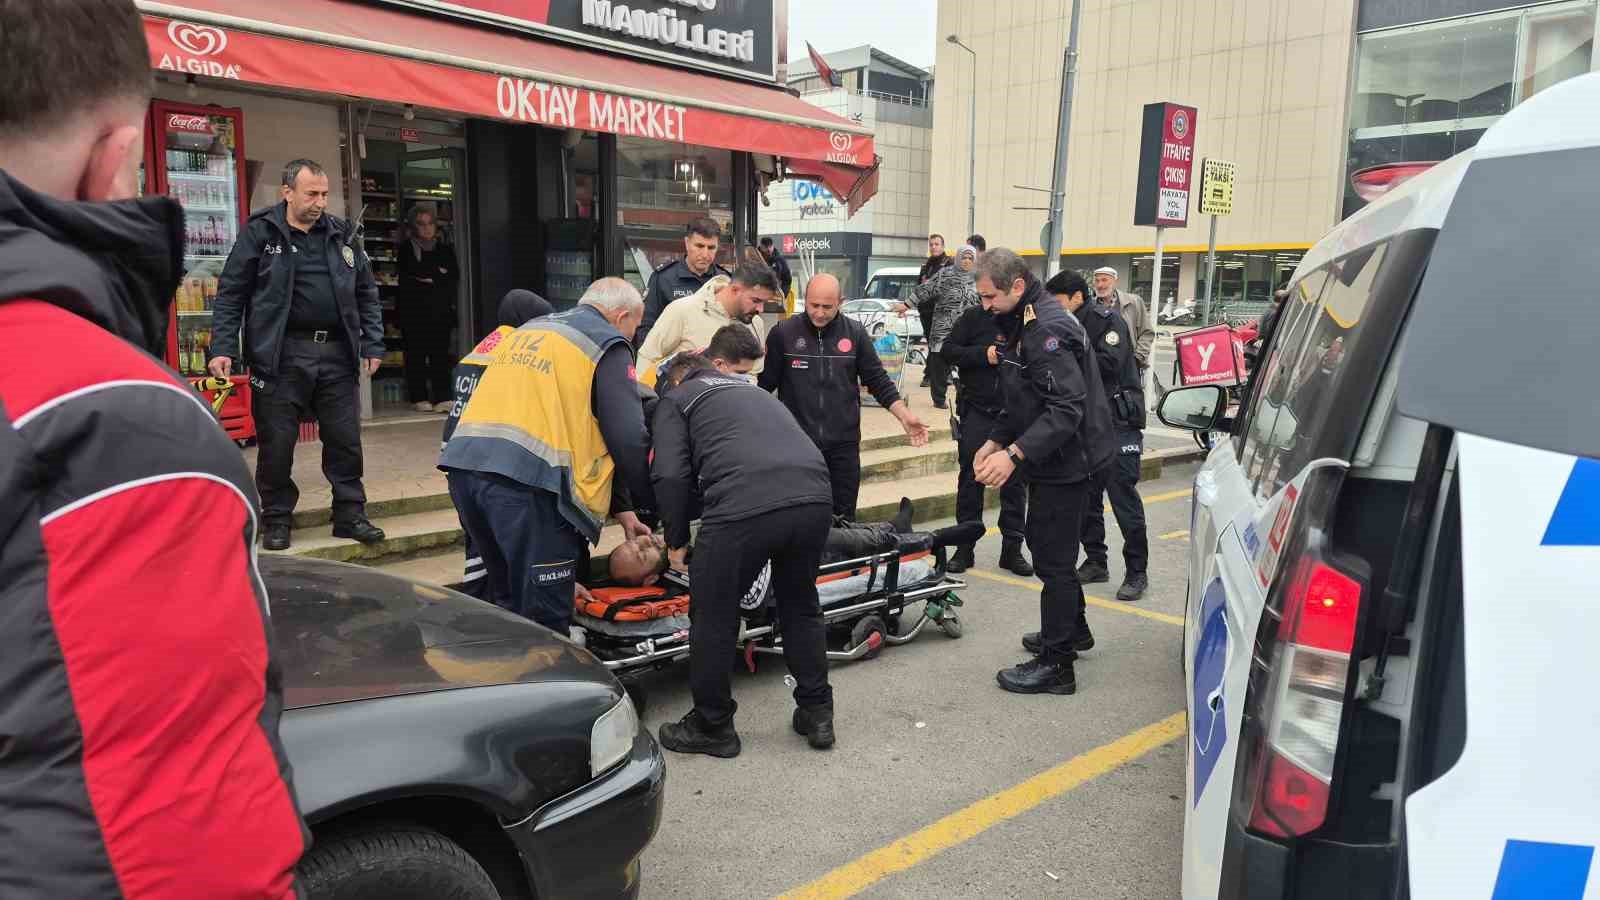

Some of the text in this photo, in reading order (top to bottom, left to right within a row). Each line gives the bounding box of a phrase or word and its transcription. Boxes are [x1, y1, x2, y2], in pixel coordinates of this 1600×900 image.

[496, 77, 687, 141] OKTAY MARKET
[1163, 139, 1191, 161] İTFAİYE
[1161, 189, 1187, 199] HAYATA
[800, 201, 834, 219] yatak
[1166, 201, 1181, 209] YOL
[1165, 210, 1180, 218] VER
[794, 235, 831, 250] Kelebek
[510, 336, 545, 352] 112
